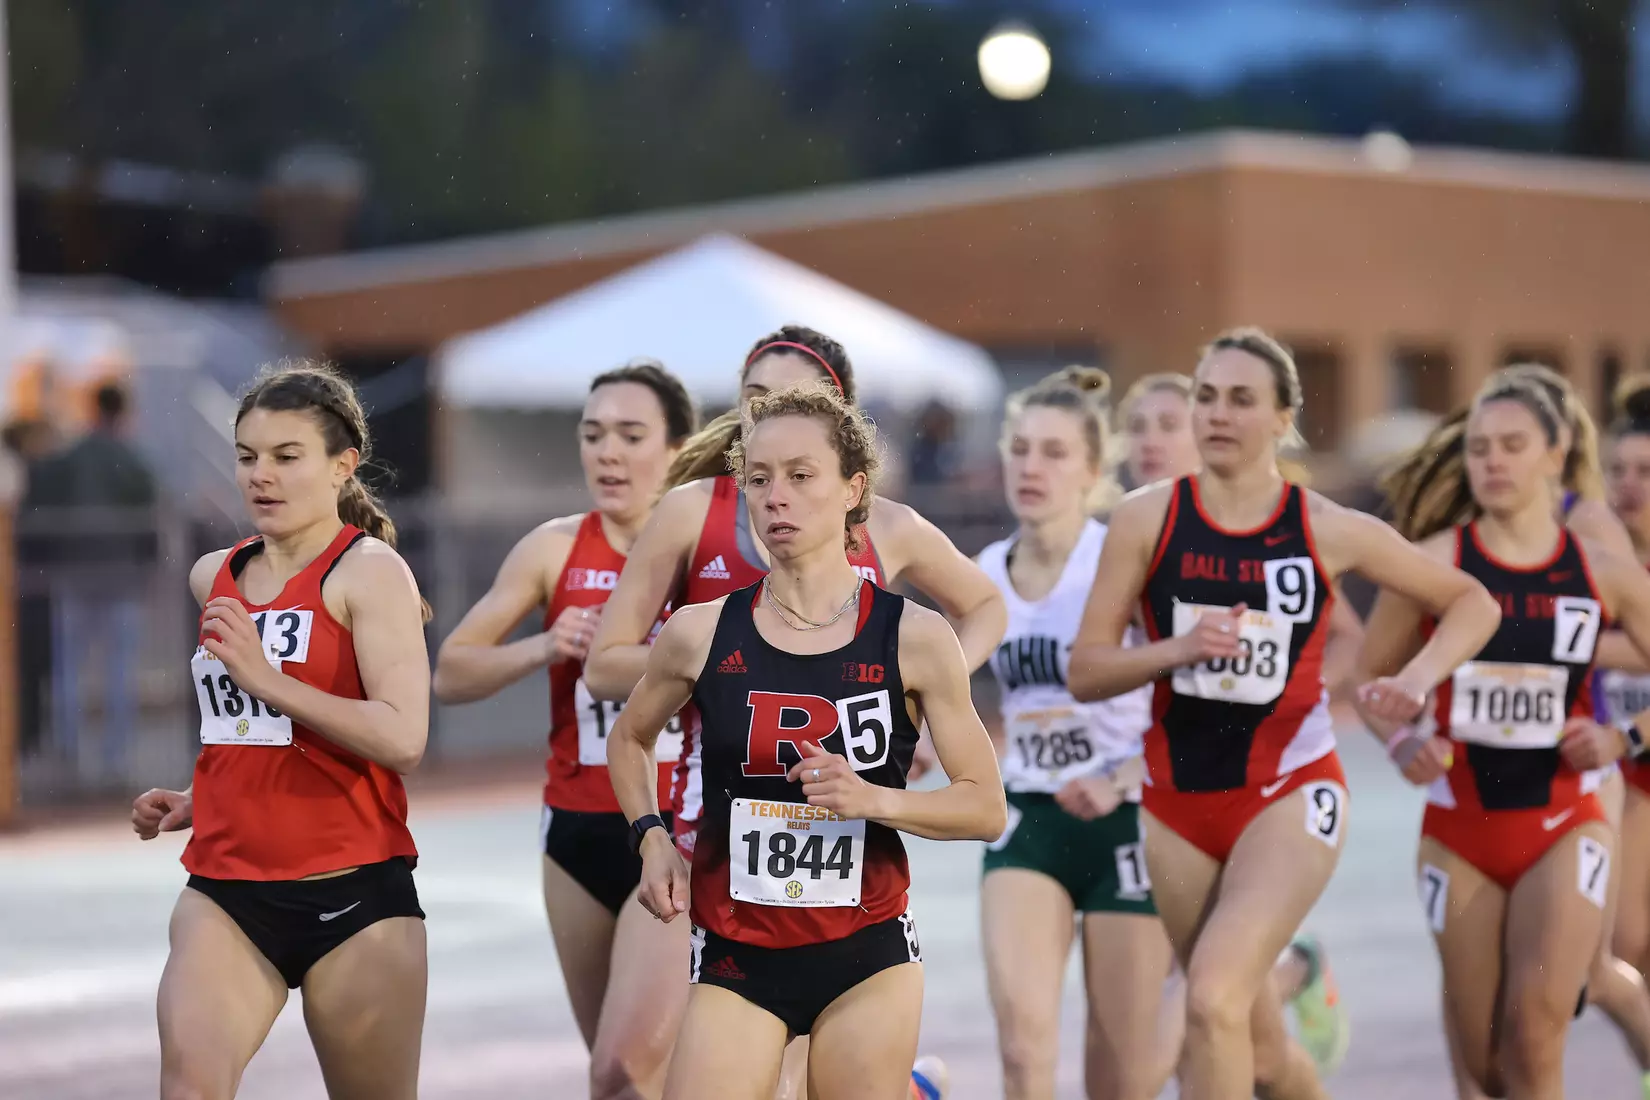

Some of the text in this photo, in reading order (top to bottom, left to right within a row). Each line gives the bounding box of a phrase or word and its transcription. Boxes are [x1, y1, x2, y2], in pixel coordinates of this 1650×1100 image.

[1180, 552, 1229, 581] BALL
[1276, 564, 1307, 615] 9
[255, 612, 300, 658] 13
[1564, 606, 1590, 652] 7
[717, 665, 748, 674] adidas
[741, 690, 839, 777] R
[846, 697, 887, 764] 5
[1016, 726, 1093, 769] 1285
[786, 821, 811, 831] RELAYS
[742, 830, 854, 880] 1844
[1585, 845, 1604, 890] 7
[1427, 873, 1442, 919] 7
